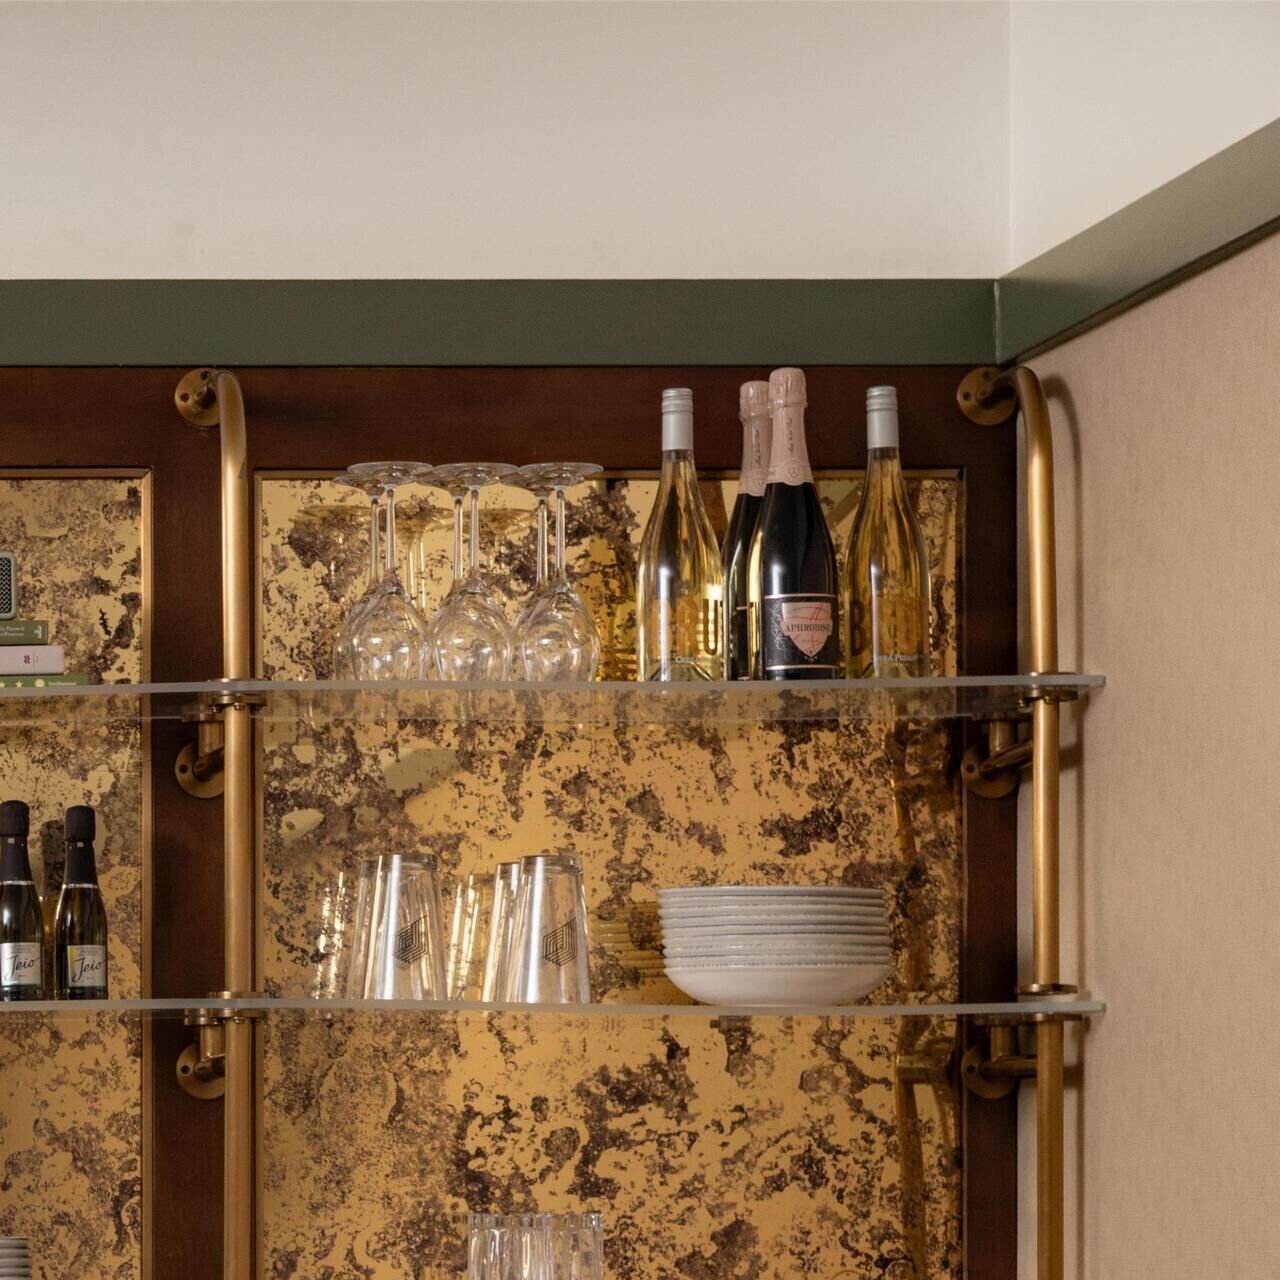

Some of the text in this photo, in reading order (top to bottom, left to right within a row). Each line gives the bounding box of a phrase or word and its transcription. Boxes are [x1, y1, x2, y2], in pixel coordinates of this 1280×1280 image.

[651, 597, 723, 656] BRU
[4, 954, 40, 981] Jeio
[72, 957, 108, 983] Jeio
